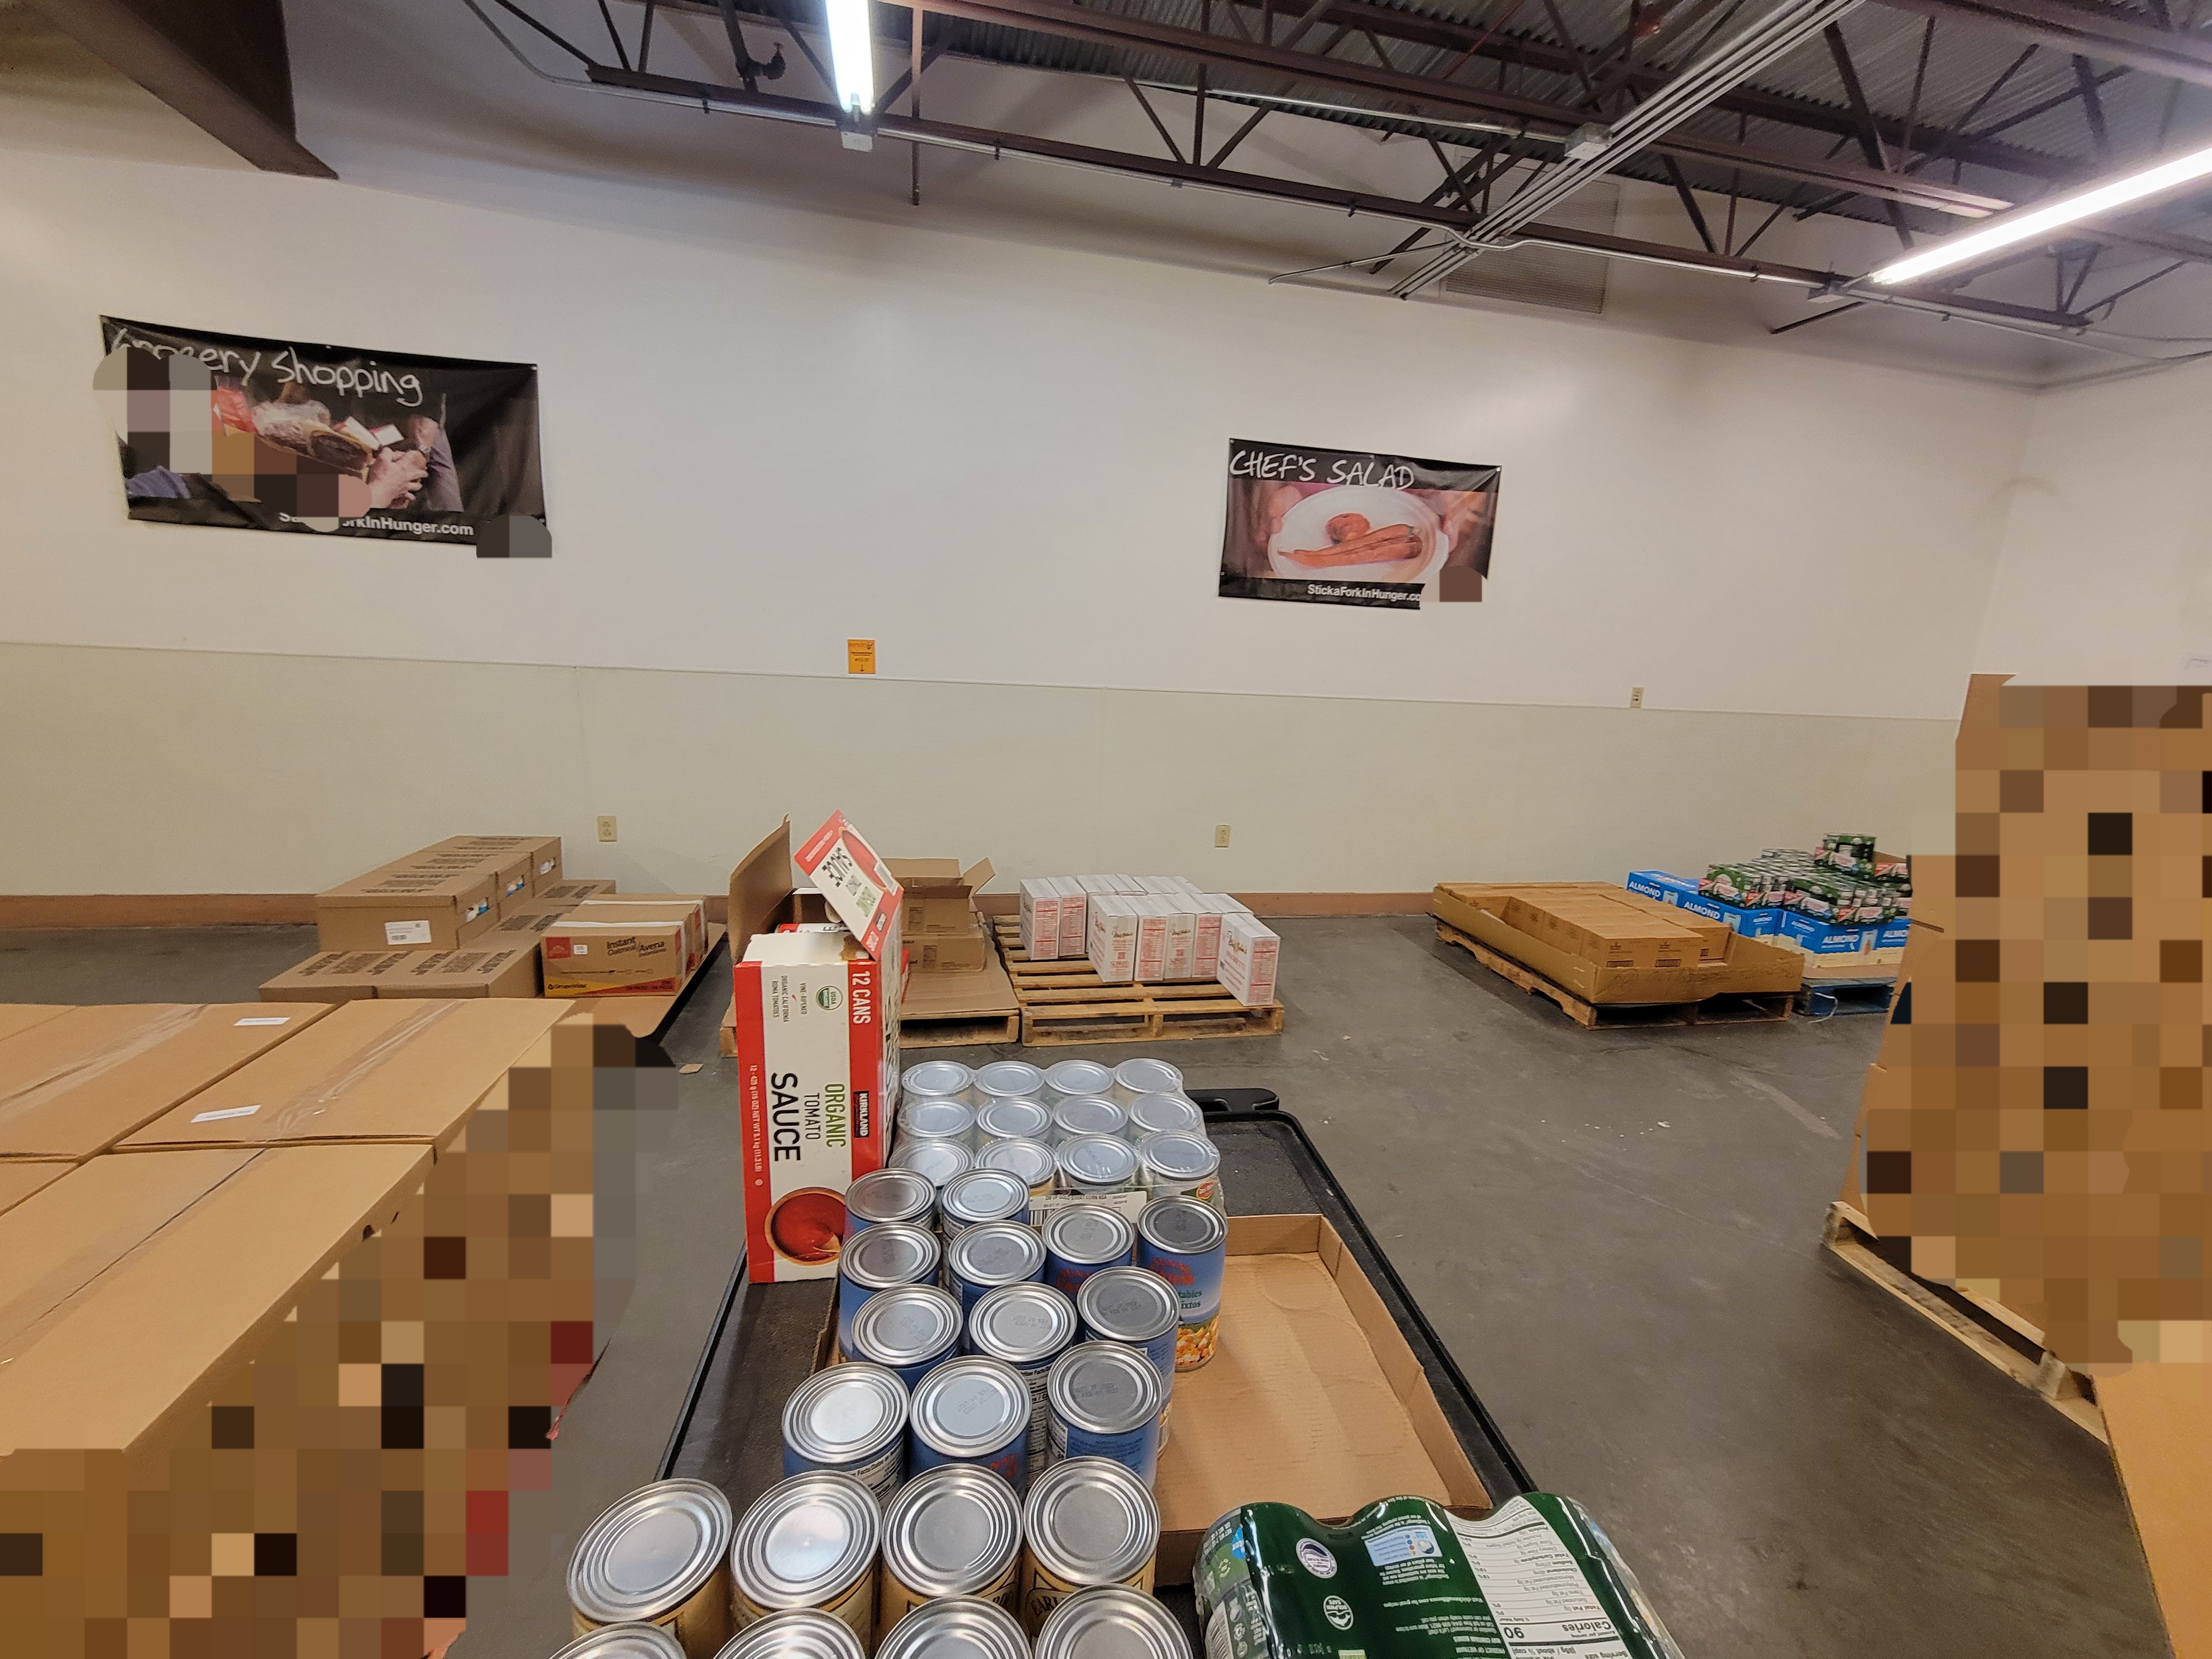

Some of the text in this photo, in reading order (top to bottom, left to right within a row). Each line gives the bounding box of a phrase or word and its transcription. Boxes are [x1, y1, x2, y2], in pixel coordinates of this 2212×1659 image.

[272, 347, 423, 407] Shopping
[1229, 450, 1414, 490] CHEF'S SALAD
[1307, 583, 1420, 602] StickaForkInHunger.co
[1629, 881, 1661, 898] ALMOND
[1684, 901, 1721, 919] ALMOND
[851, 971, 872, 1024] 12 CANS
[752, 1111, 760, 1121] NET
[771, 1073, 800, 1161] SAUCE
[804, 1093, 821, 1140] TOMATO
[824, 1084, 847, 1148] ORGANIC
[859, 1093, 869, 1137] KIRKLAND
[753, 1123, 760, 1132] WT
[1178, 1290, 1202, 1299] tables
[1180, 1301, 1201, 1309] ixtos
[1504, 1621, 1612, 1639] Calories 90
[1599, 1650, 1628, 1658] Serving
